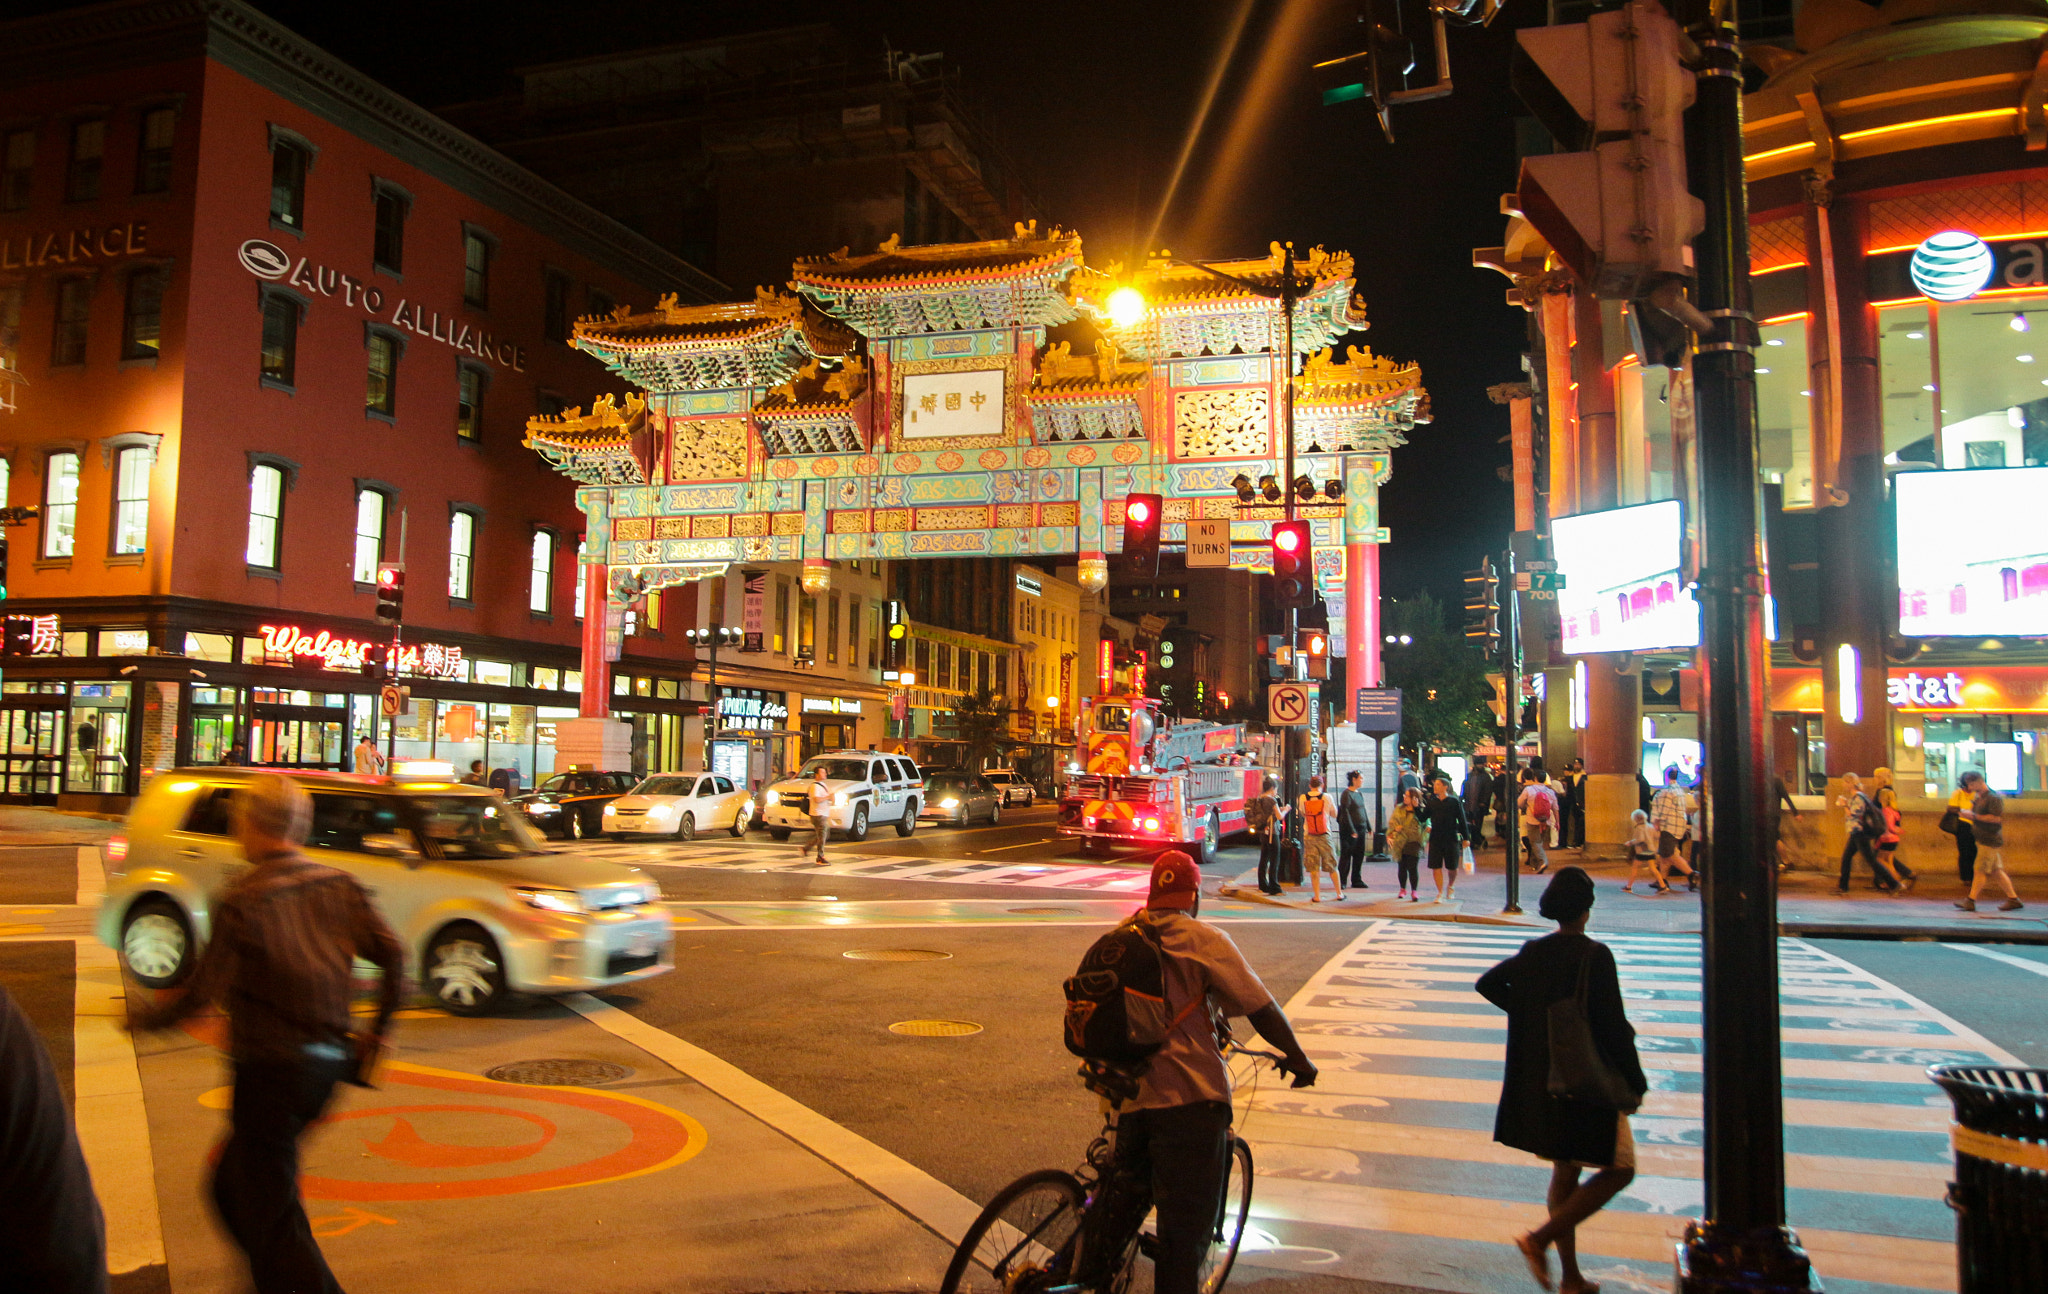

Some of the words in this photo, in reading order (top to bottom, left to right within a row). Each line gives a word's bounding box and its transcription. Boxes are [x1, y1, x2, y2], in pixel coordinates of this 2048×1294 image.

[2004, 242, 2048, 287] a
[289, 257, 385, 315] AUTO
[391, 299, 527, 373] ALLIANCE
[1201, 524, 1215, 536] NO
[1192, 543, 1225, 554] TURNS
[1536, 574, 1546, 588] 7
[1529, 591, 1555, 600] 700
[1886, 672, 1964, 705] at&t
[724, 697, 746, 715] SPORTS
[746, 699, 762, 717] ZONE
[1310, 699, 1319, 735] Gallery
[880, 792, 900, 804] POLICE
